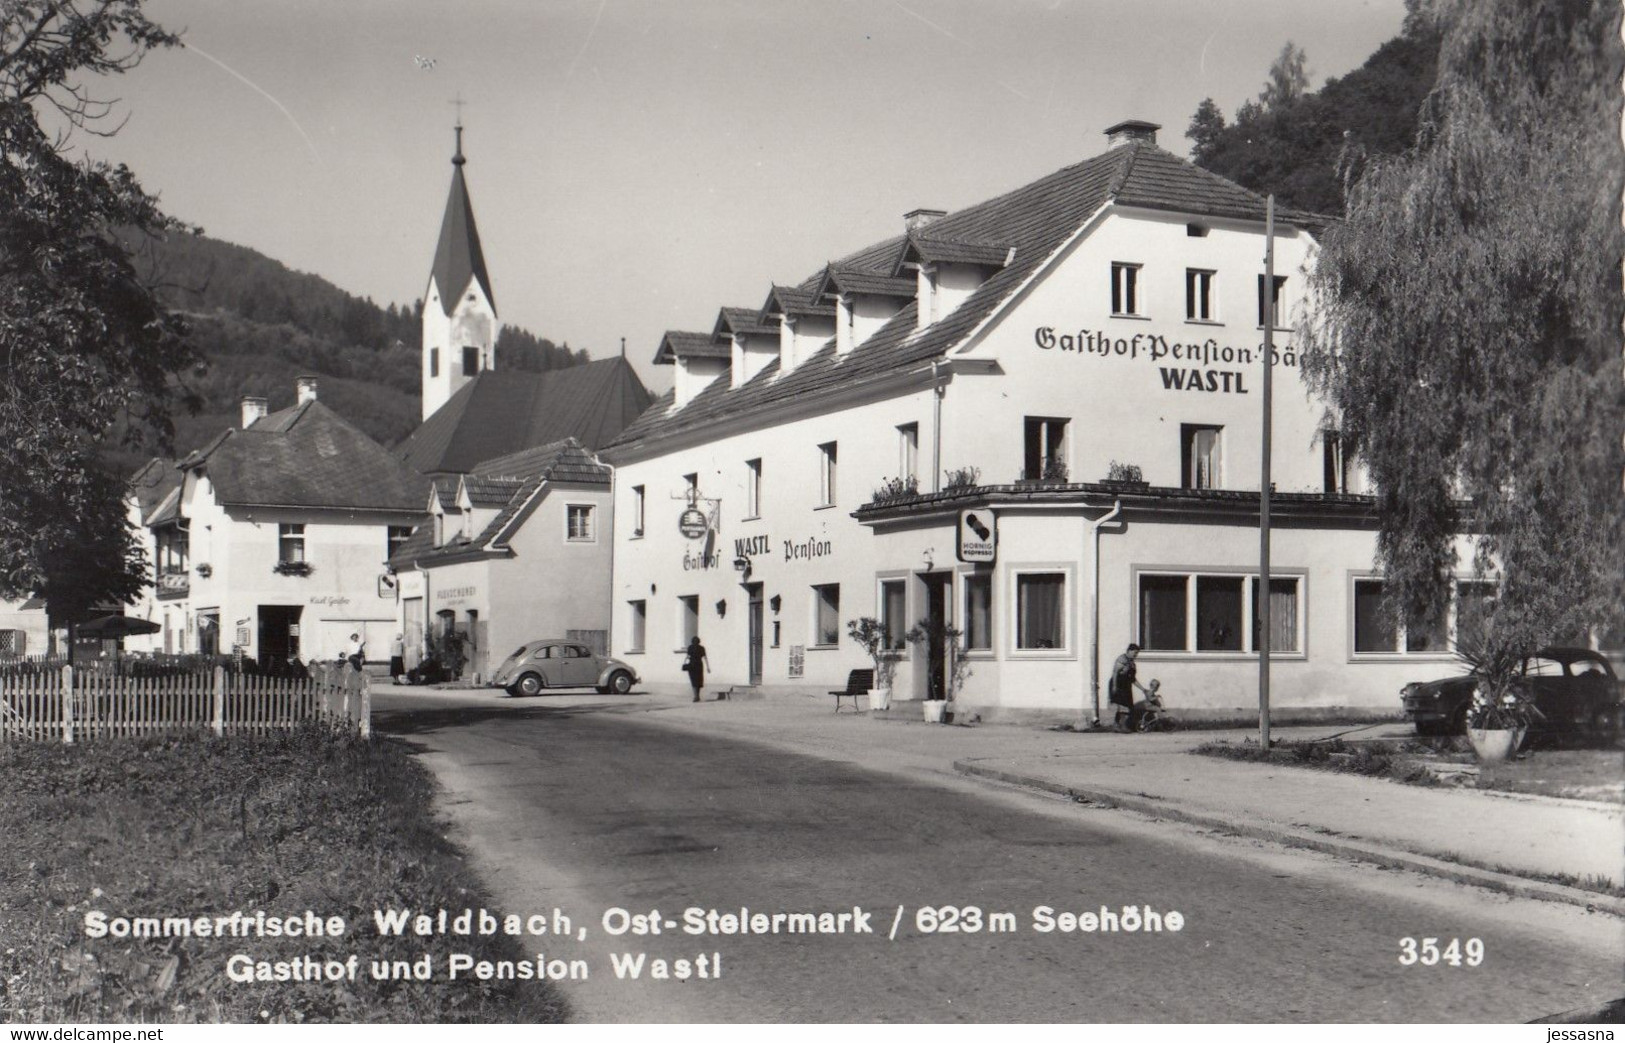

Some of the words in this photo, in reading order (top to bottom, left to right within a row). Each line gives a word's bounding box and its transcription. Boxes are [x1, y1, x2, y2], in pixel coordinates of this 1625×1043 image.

[1160, 367, 1249, 394] WASTL
[735, 535, 770, 557] WASTL
[783, 536, 831, 562] Pension
